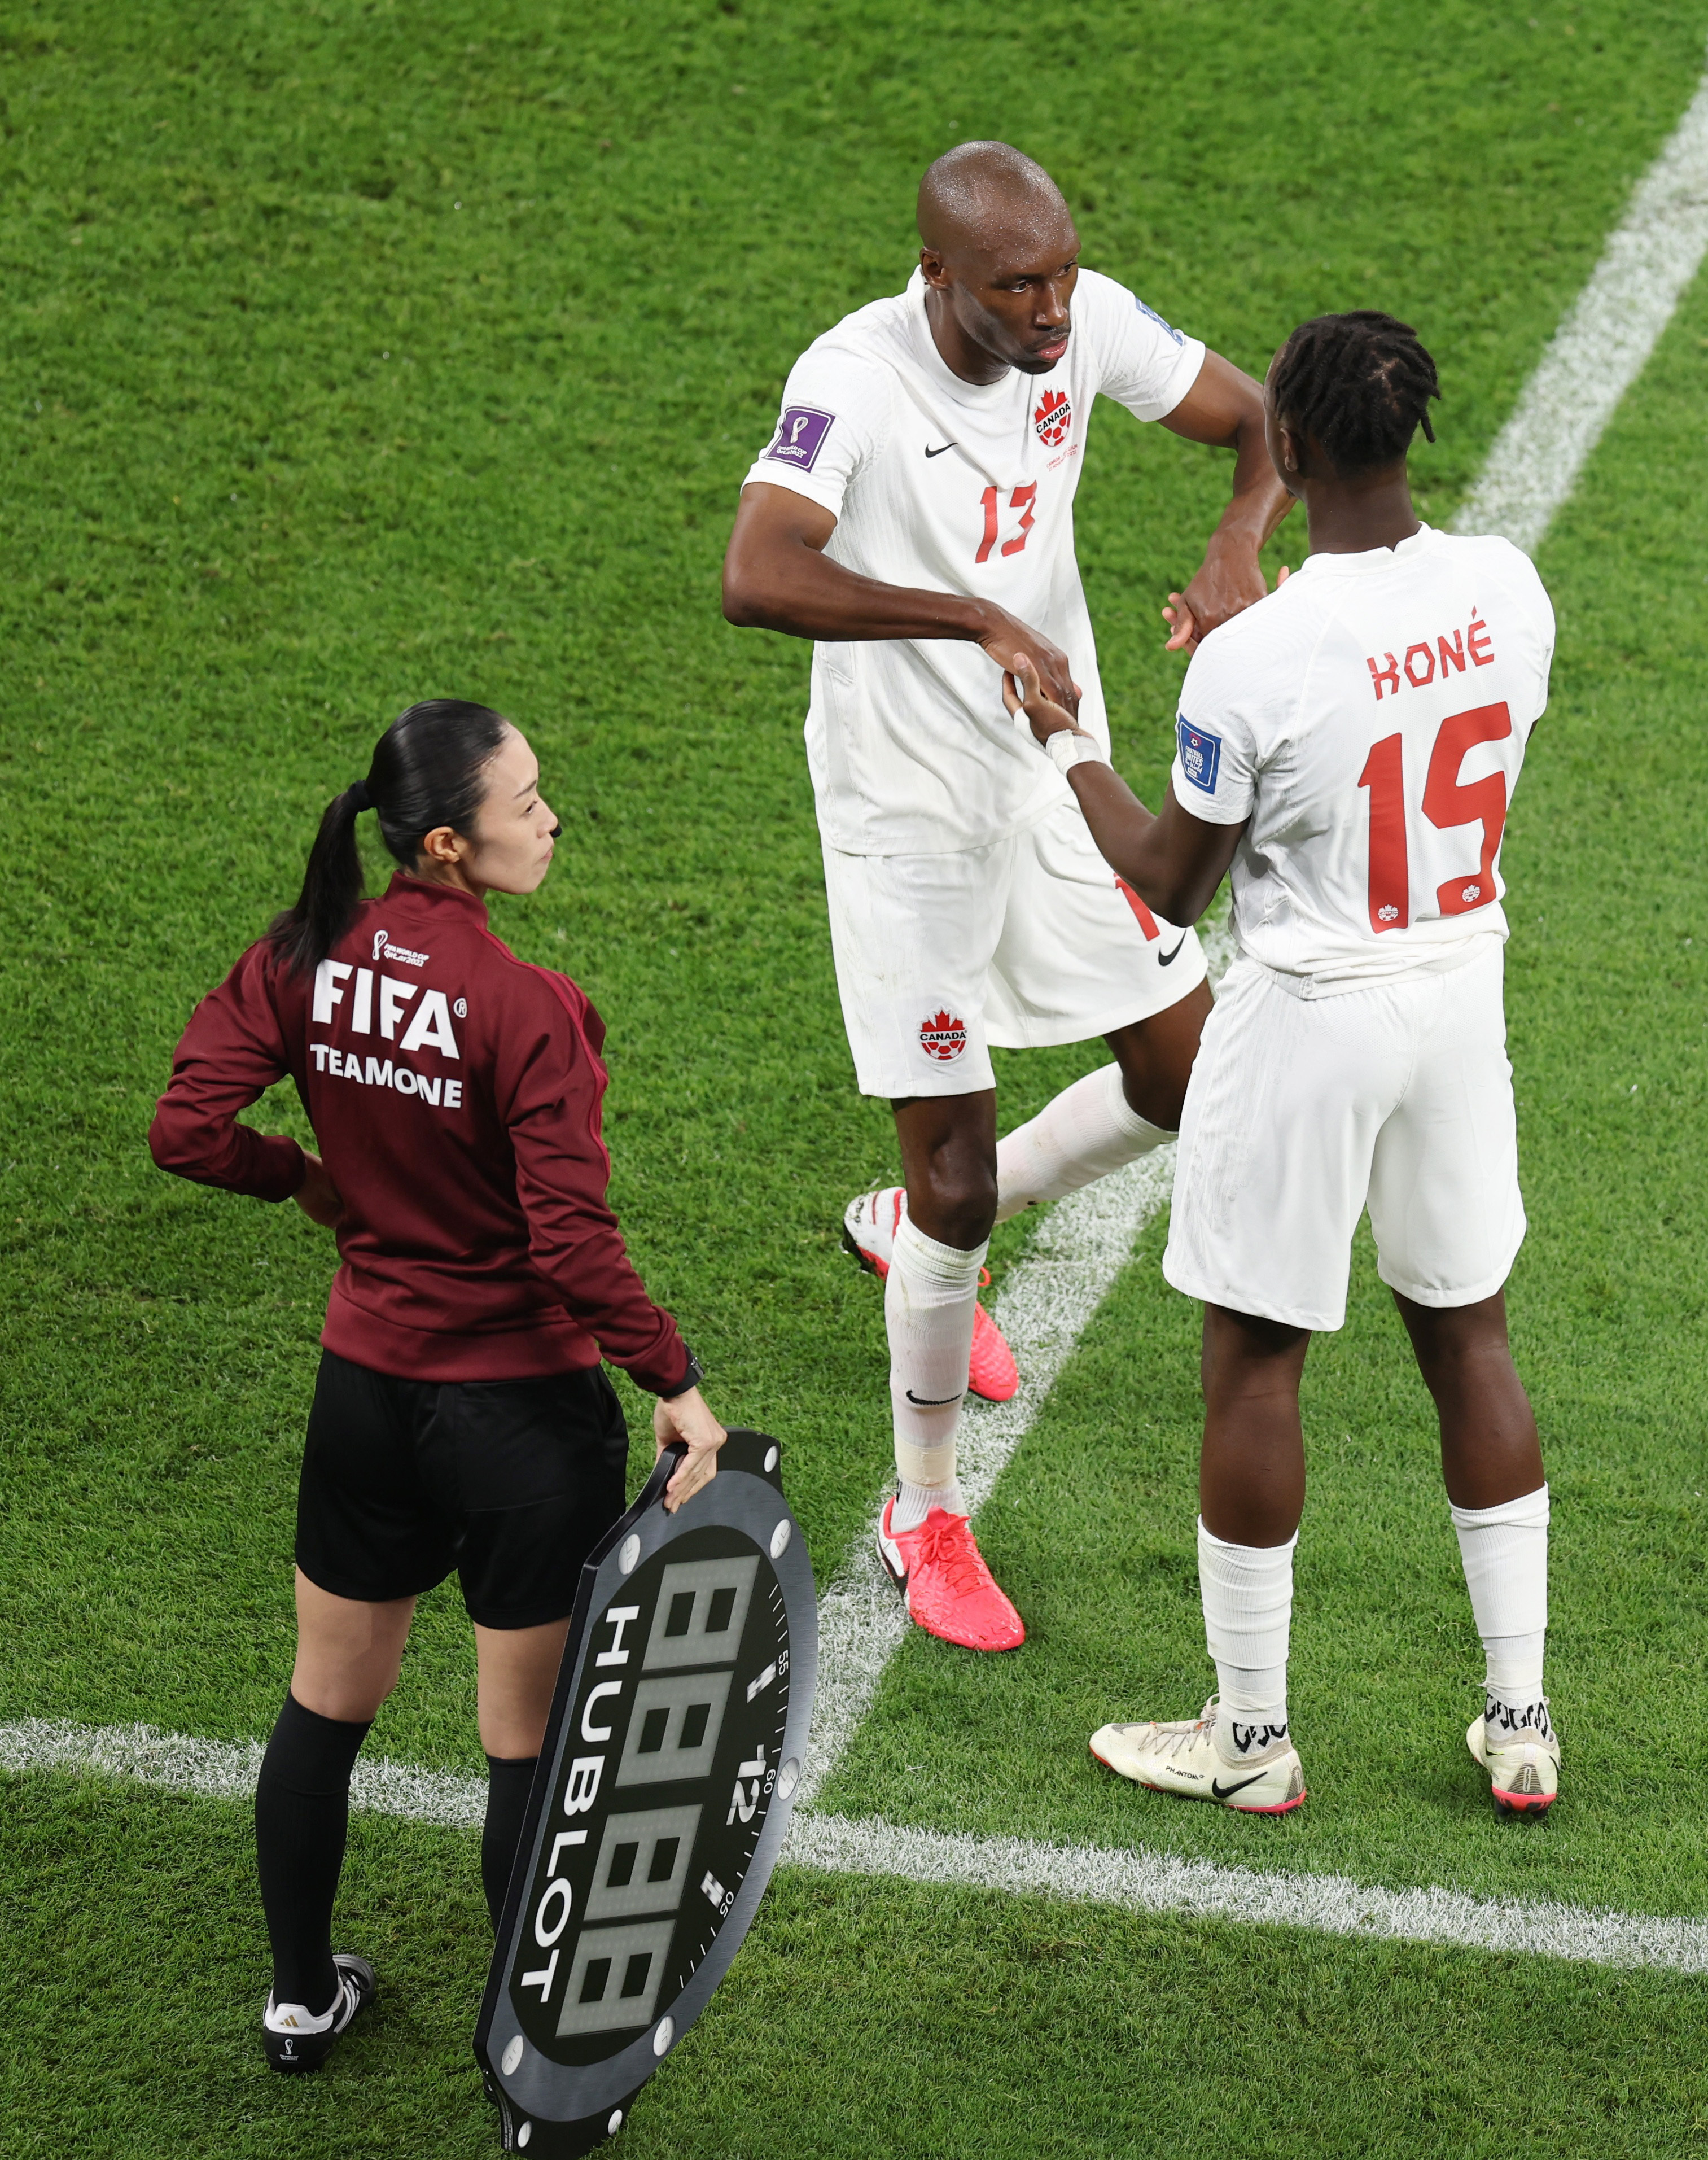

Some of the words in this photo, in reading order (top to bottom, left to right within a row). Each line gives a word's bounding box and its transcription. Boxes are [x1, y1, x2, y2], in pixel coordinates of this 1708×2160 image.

[1036, 403, 1071, 434] CANADA
[1063, 443, 1078, 456] GIUM
[975, 479, 1037, 563] 13
[1367, 606, 1495, 701] KONÉ
[1185, 745, 1203, 759] FOOTBALL
[1185, 750, 1203, 767] UNITES
[1357, 701, 1512, 934] 15
[1114, 873, 1160, 941] 1
[384, 943, 396, 952] FIFA
[396, 947, 418, 958] WORLD
[919, 1031, 966, 1041] CANADA
[778, 1649, 789, 1676] 55
[726, 1744, 767, 1825] 12
[763, 1768, 777, 1794] 60
[1166, 1765, 1199, 1780] PHANTOM
[521, 1605, 640, 2003] HUBLOT
[720, 1891, 734, 1918] 05
